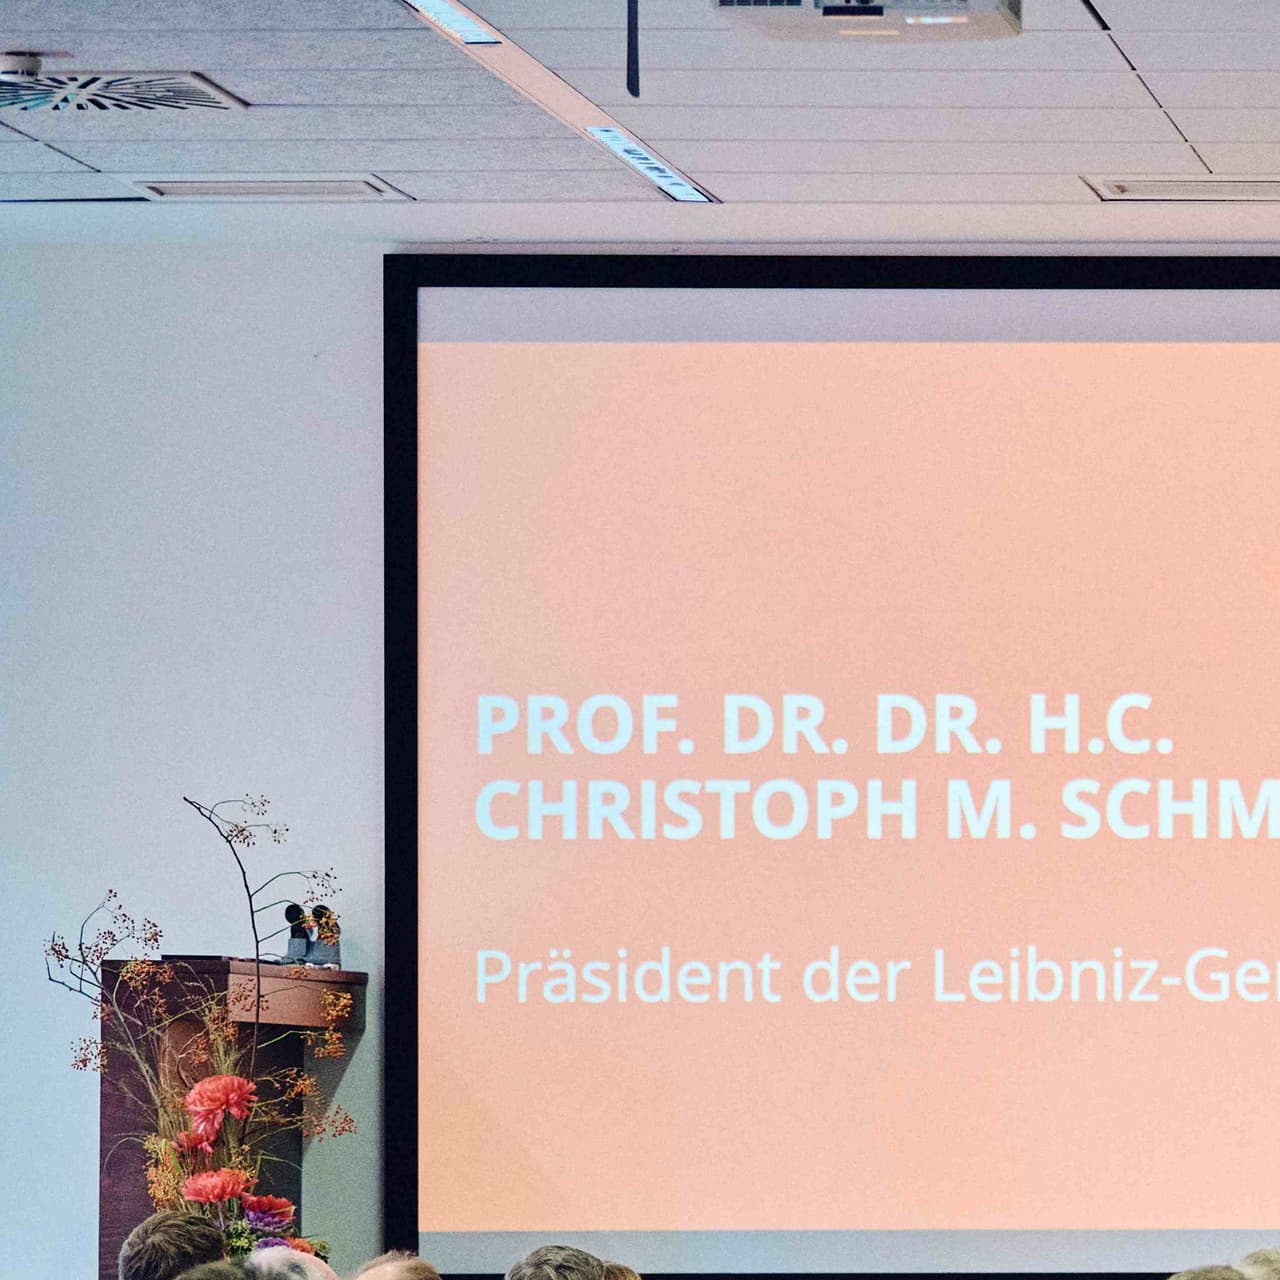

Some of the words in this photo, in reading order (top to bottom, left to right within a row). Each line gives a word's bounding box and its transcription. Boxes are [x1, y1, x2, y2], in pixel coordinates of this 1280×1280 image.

[476, 693, 695, 755] PROF.
[724, 693, 848, 755] DR.
[877, 693, 1002, 755] DR.
[1029, 693, 1174, 755] H.C.
[475, 778, 917, 841] CHRISTOPH
[947, 778, 1037, 840] M.
[476, 946, 782, 1003] Präsident
[802, 945, 912, 1003] der
